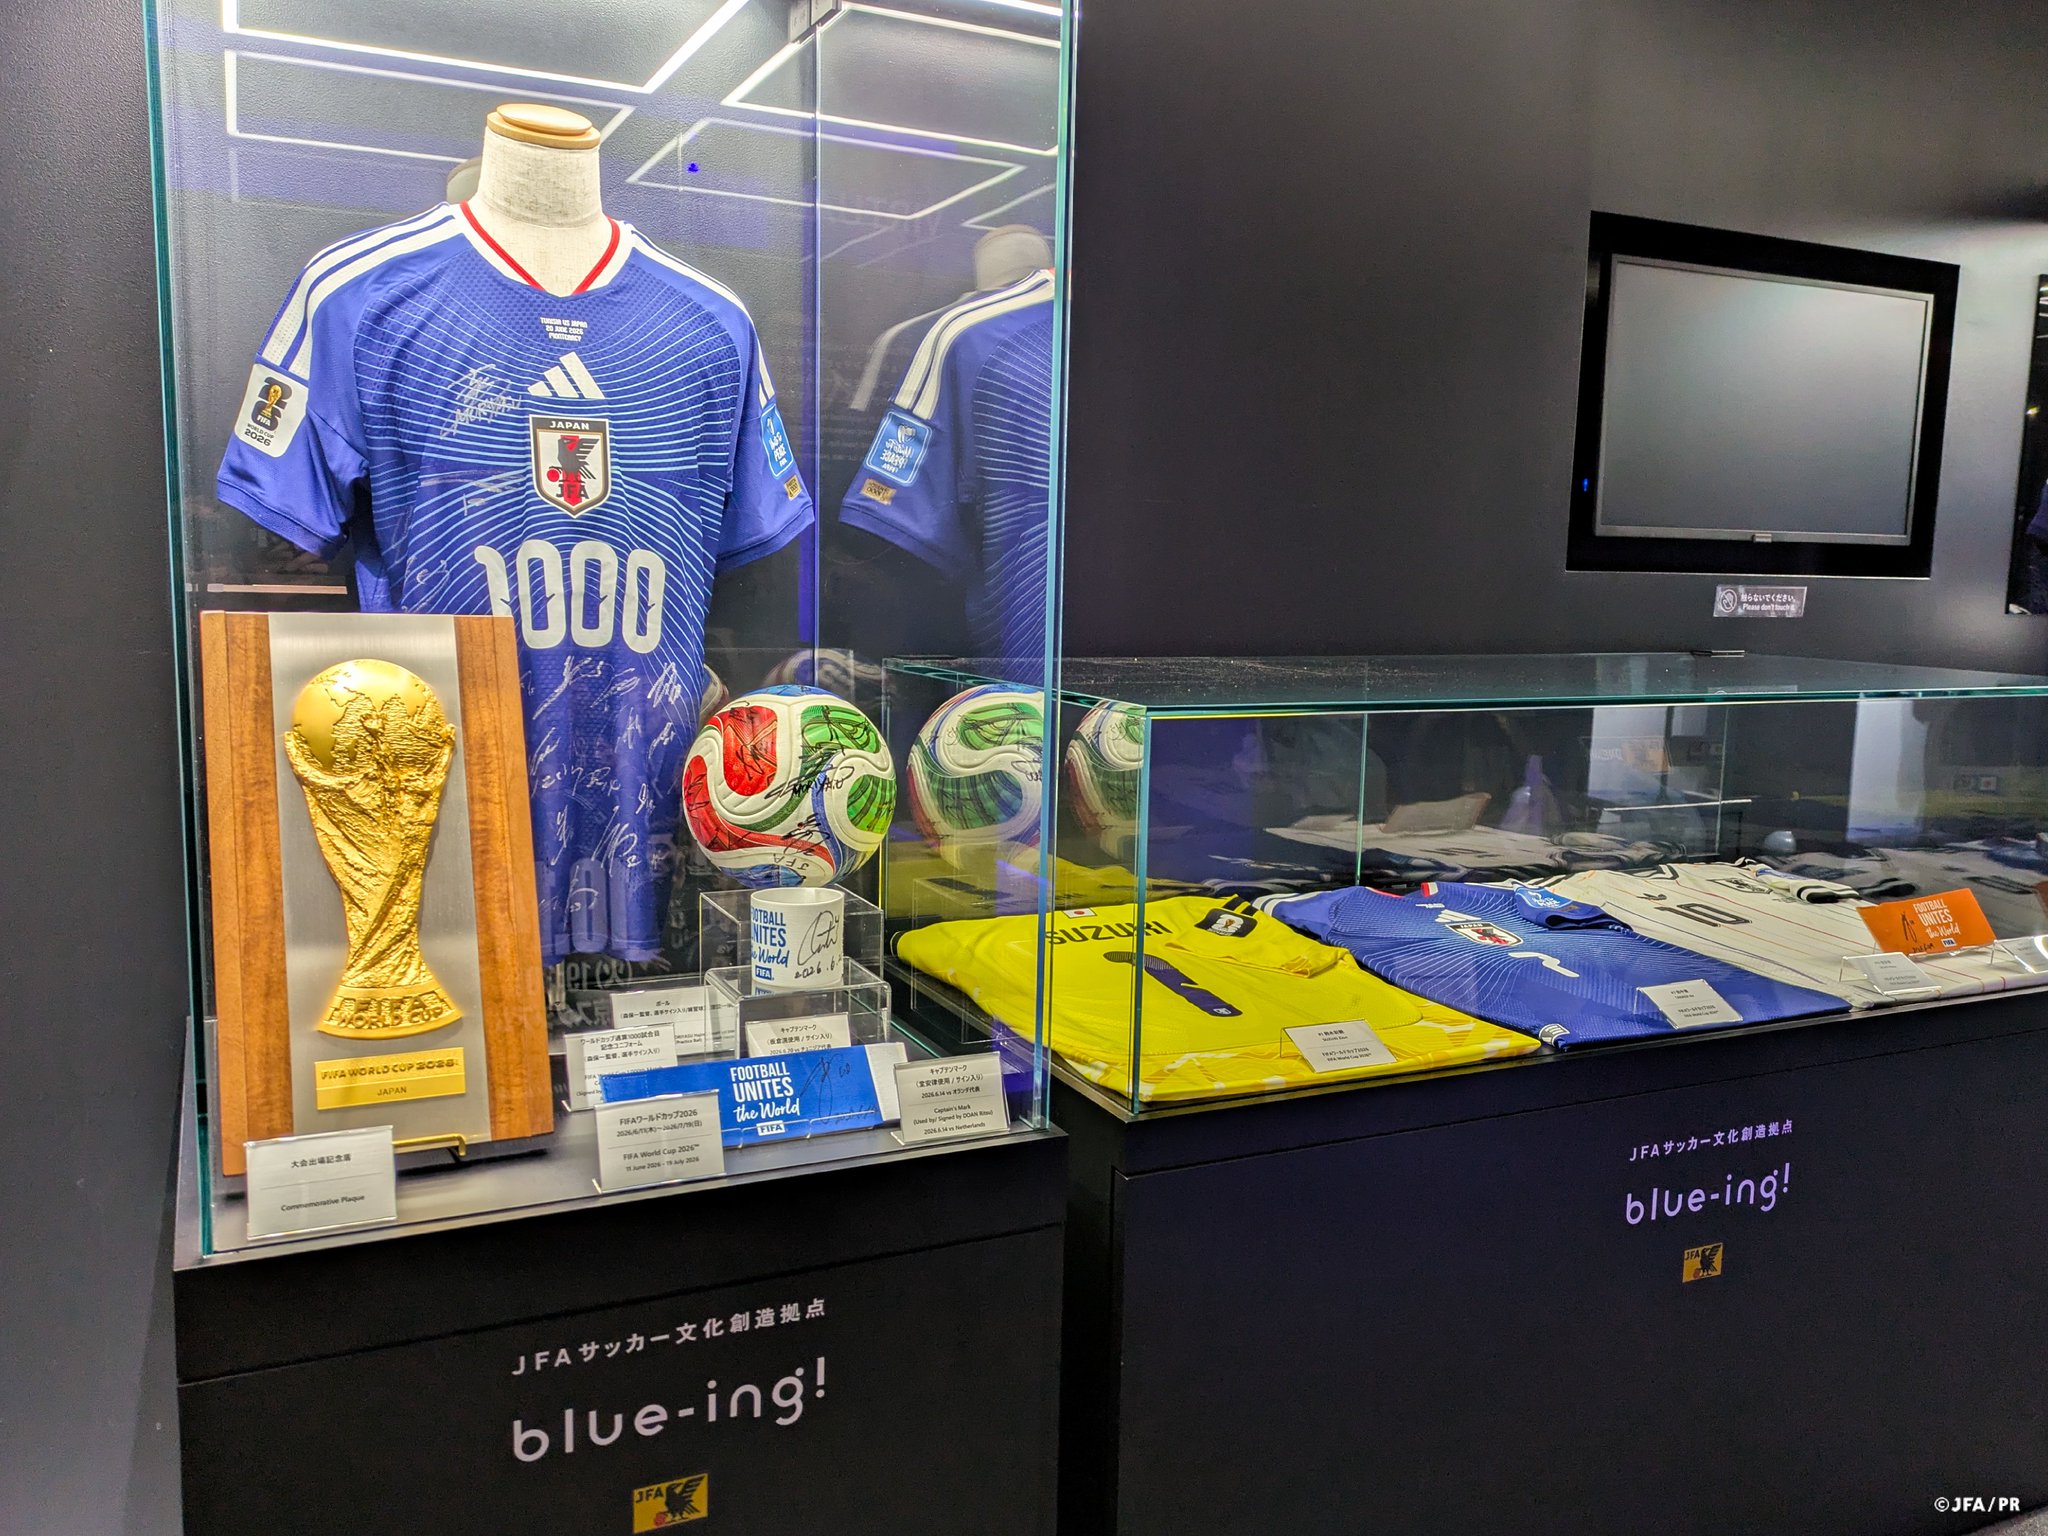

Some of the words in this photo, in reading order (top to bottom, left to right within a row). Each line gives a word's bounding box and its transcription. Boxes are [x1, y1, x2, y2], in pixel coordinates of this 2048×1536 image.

[256, 414, 272, 427] FIFA
[549, 420, 590, 430] JAPAN
[244, 428, 272, 447] 2026
[556, 483, 590, 499] JFA
[474, 539, 666, 654] 1000
[1655, 902, 1753, 928] 10
[1913, 898, 1948, 914] FOOTBALL
[1918, 908, 1954, 927] UNITES
[751, 923, 787, 948] NITES
[758, 946, 790, 968] World
[756, 968, 771, 978] FIFA
[357, 997, 427, 1016] FIFA
[409, 1006, 444, 1024] CUP
[320, 1068, 347, 1080] FIFA
[347, 1064, 391, 1077] WORLD
[392, 1063, 415, 1073] CUP
[730, 1062, 790, 1082] FOOTBALL
[930, 1064, 968, 1075] キャプテンマーク
[376, 1086, 407, 1096] JAPAN
[733, 1076, 794, 1103] UNITES
[734, 1102, 759, 1123] the
[758, 1098, 800, 1119] World
[760, 1124, 784, 1134] FIFA
[1629, 1119, 1793, 1162] JFAサッカー文化創造拠点
[623, 1152, 639, 1160] FIFA
[640, 1149, 661, 1158] World
[662, 1147, 677, 1156] Cup
[1625, 1162, 1791, 1225] blue-ing!
[280, 1198, 340, 1212] Commemorative
[340, 1195, 366, 1204] Plaque
[1684, 1250, 1700, 1260] JFA
[511, 1298, 826, 1376] JFAサッカー文化創造拠点
[512, 1356, 826, 1462] blue-ing!
[635, 1485, 665, 1504] JFA
